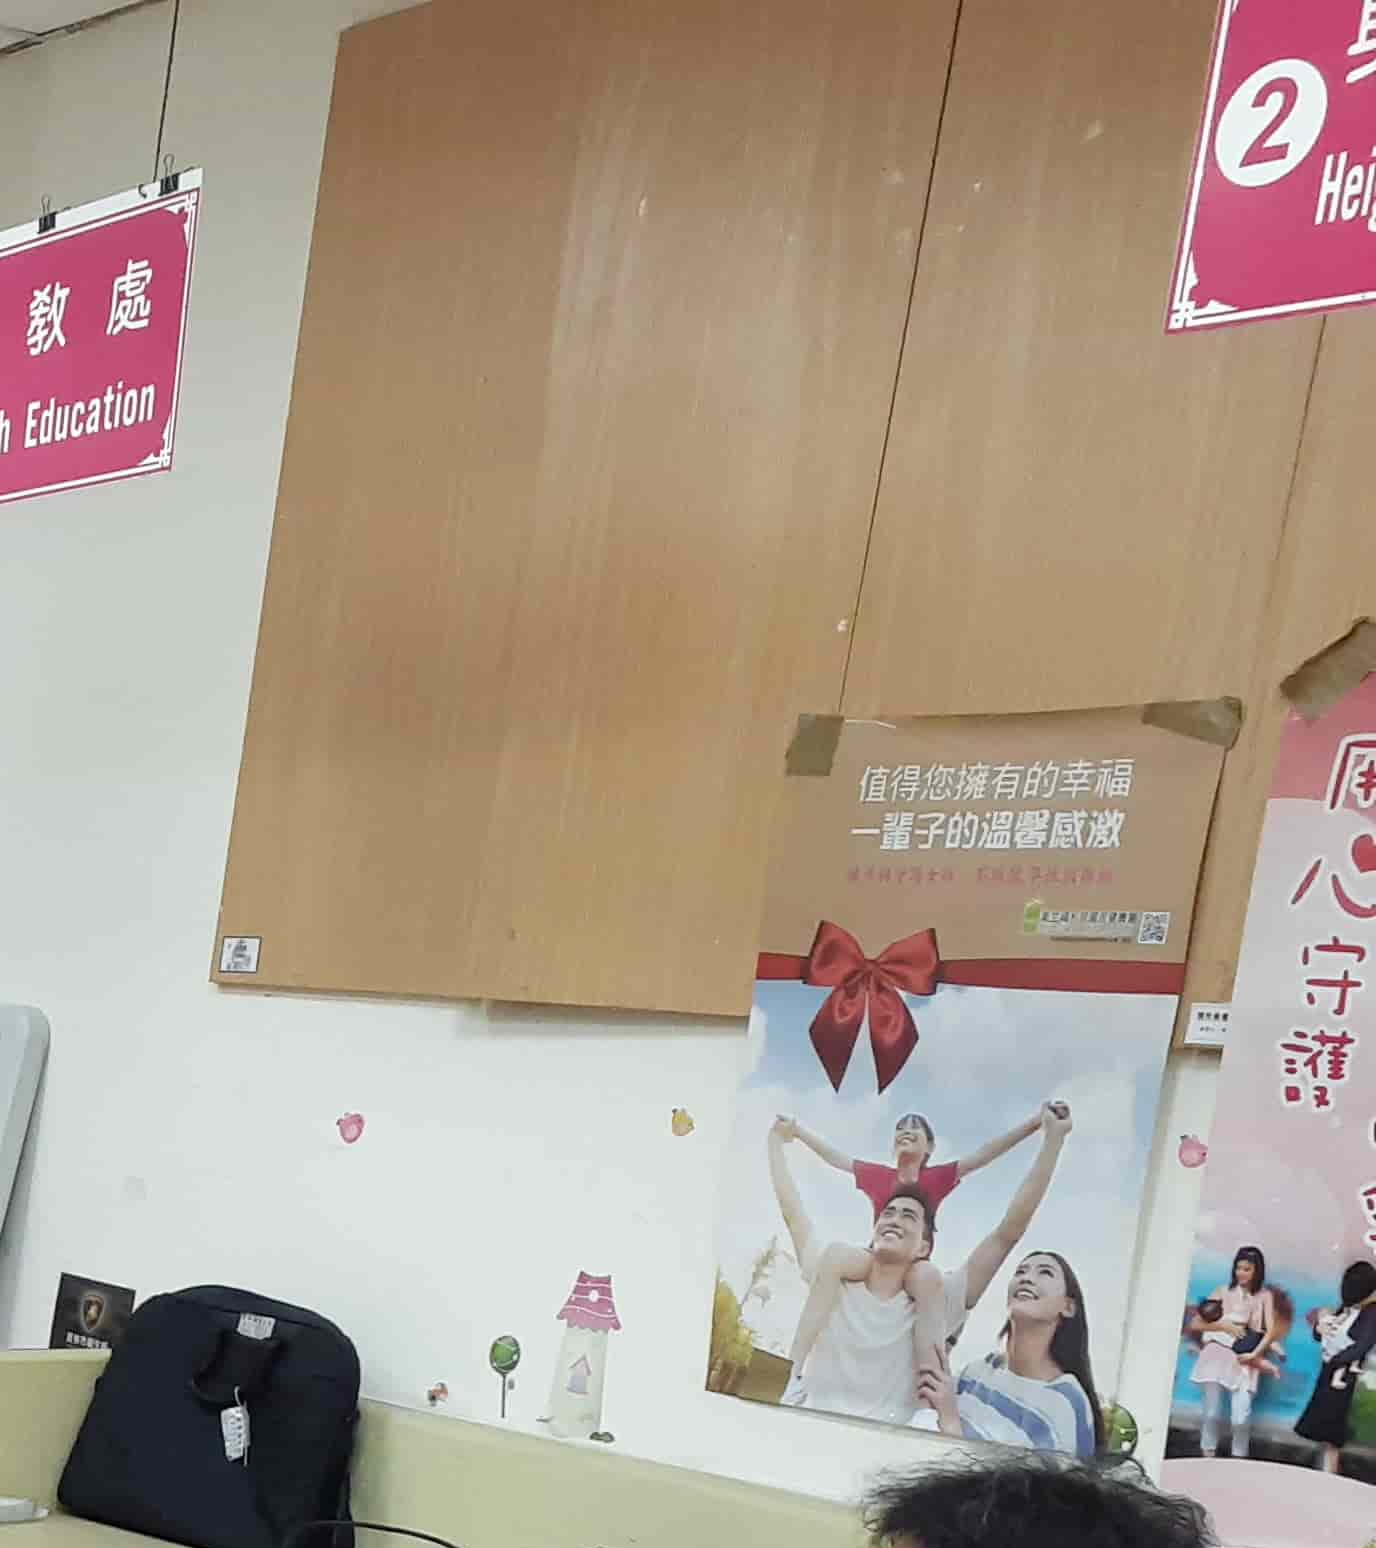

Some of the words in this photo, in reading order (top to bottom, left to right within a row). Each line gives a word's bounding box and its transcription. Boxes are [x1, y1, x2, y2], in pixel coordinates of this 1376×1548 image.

[23, 381, 155, 449] Education
[858, 758, 1135, 803] 值得您擁有的幸福
[850, 808, 1126, 850] 一輩子的溫馨感激
